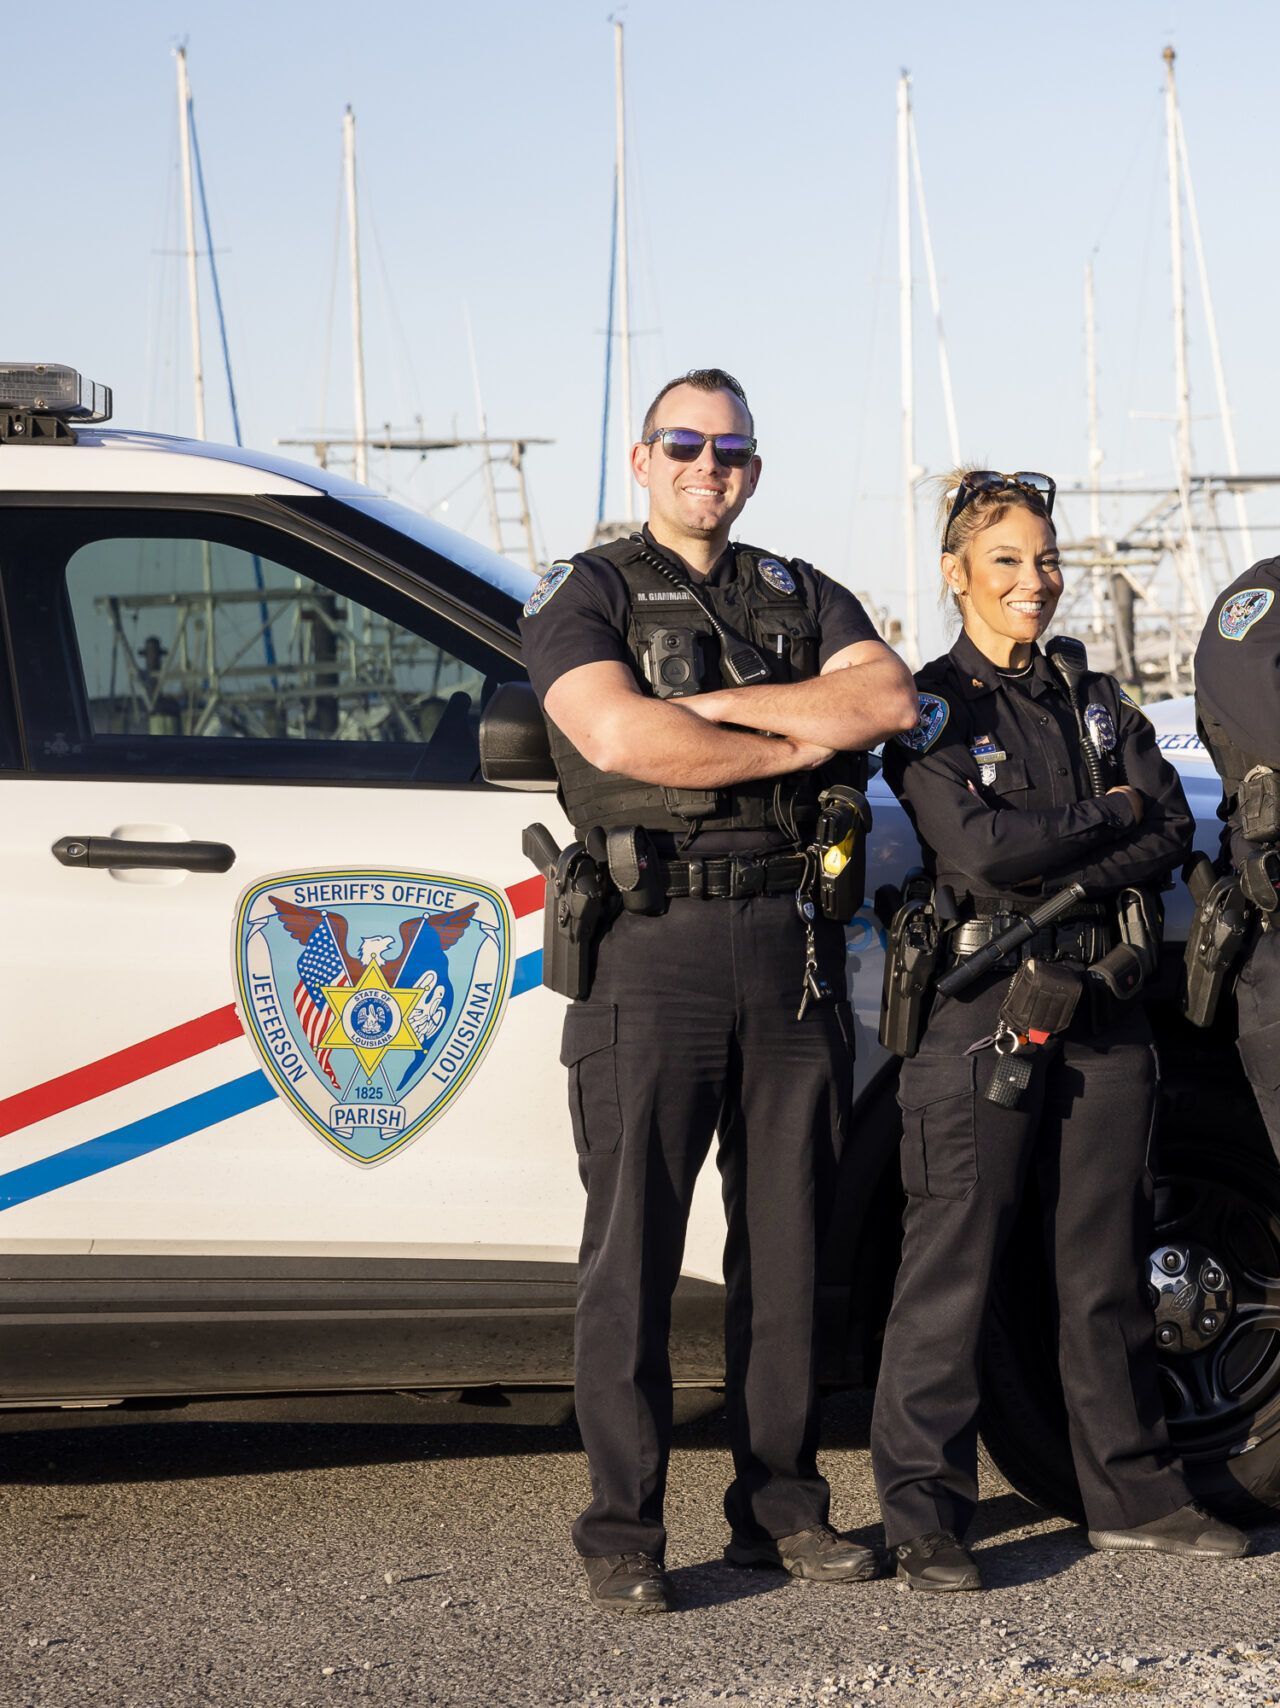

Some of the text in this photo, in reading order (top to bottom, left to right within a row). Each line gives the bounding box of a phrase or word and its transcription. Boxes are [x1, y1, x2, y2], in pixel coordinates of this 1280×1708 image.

[637, 593, 648, 601] M.
[294, 883, 456, 909] SHERIFF'S OFFICE
[354, 991, 392, 1003] STATE OF
[252, 973, 308, 1084] JEFFERSON
[431, 981, 492, 1084] LOUISIANA
[350, 1033, 393, 1047] LOUISIANA
[354, 1086, 383, 1100] 1825
[335, 1107, 401, 1127] PARISH
